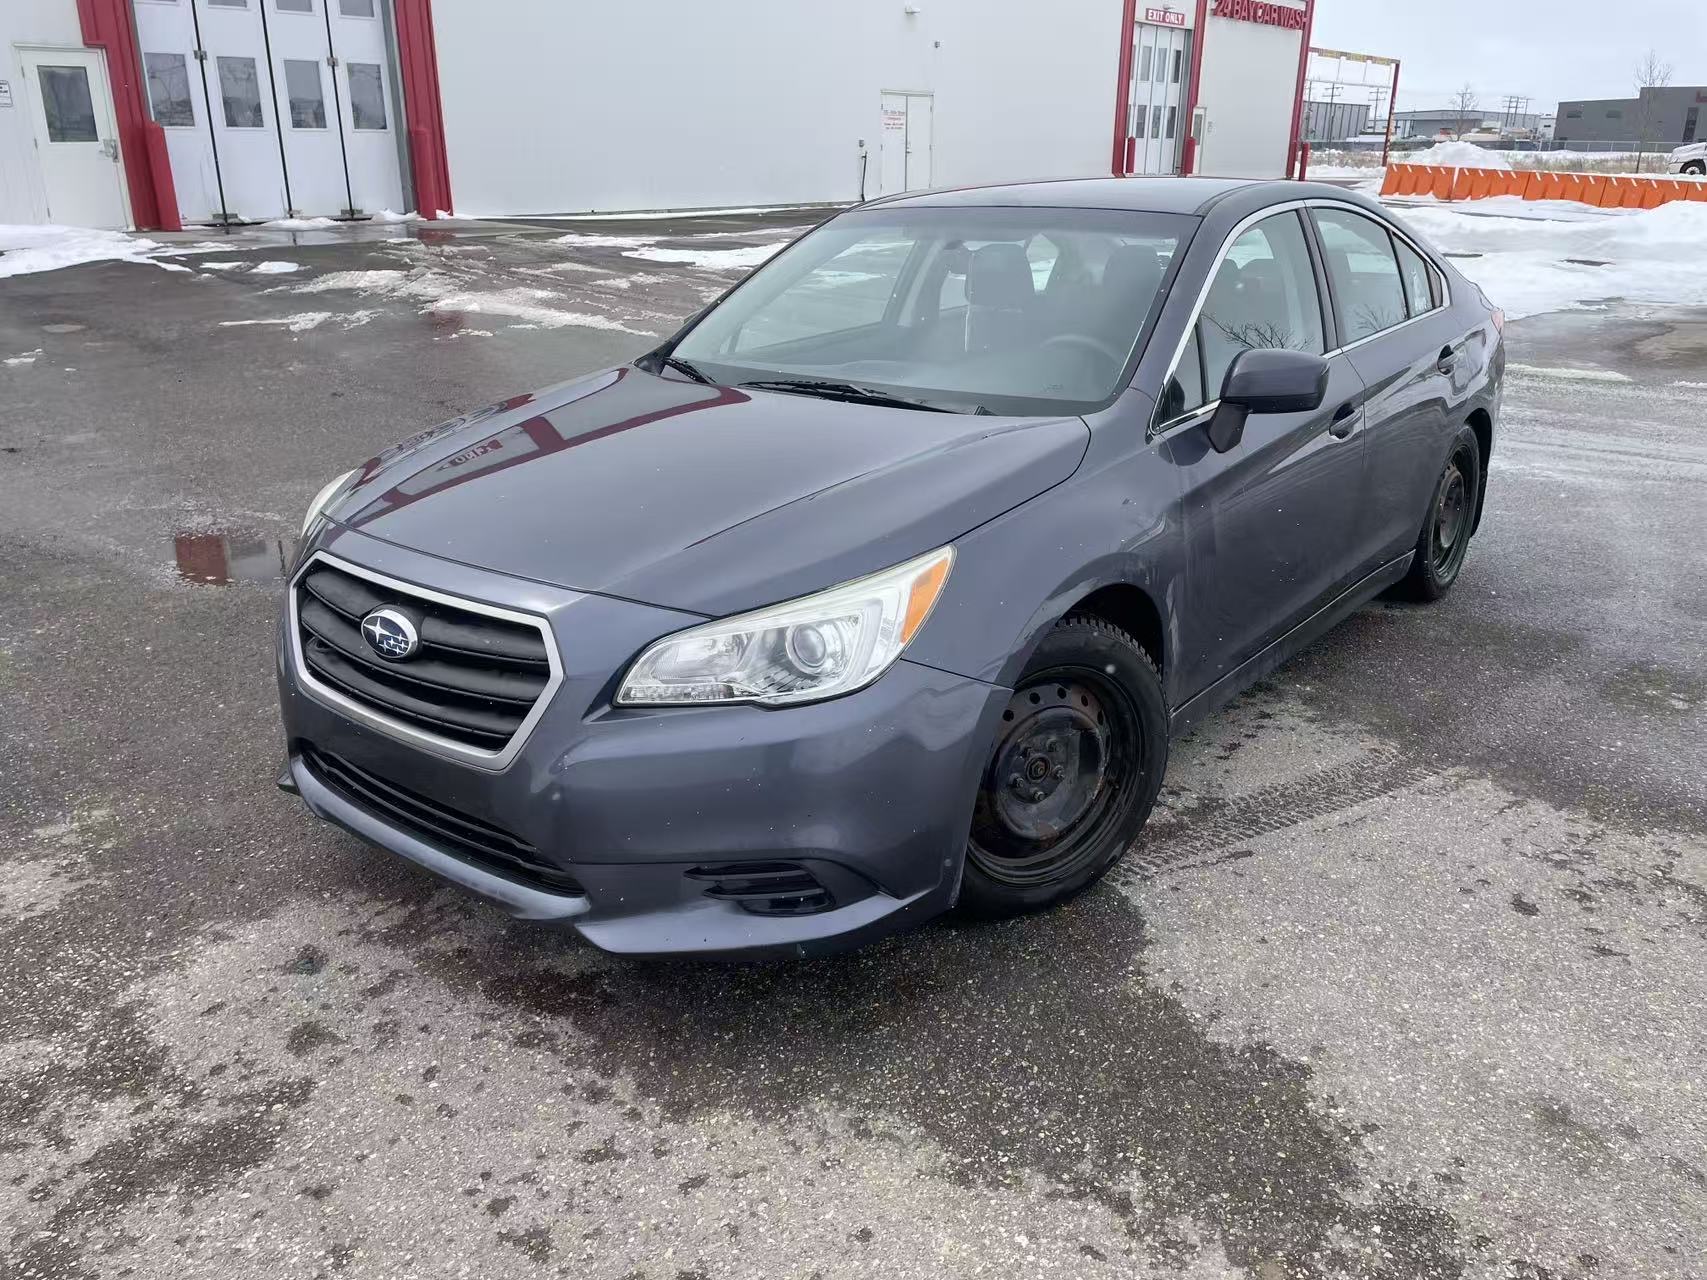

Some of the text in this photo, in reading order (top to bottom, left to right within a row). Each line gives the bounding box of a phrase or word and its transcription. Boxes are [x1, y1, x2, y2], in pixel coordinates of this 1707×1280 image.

[1148, 10, 1184, 25] EXIT ONLY
[1215, 0, 1309, 30] 24 BAY CAR WASH
